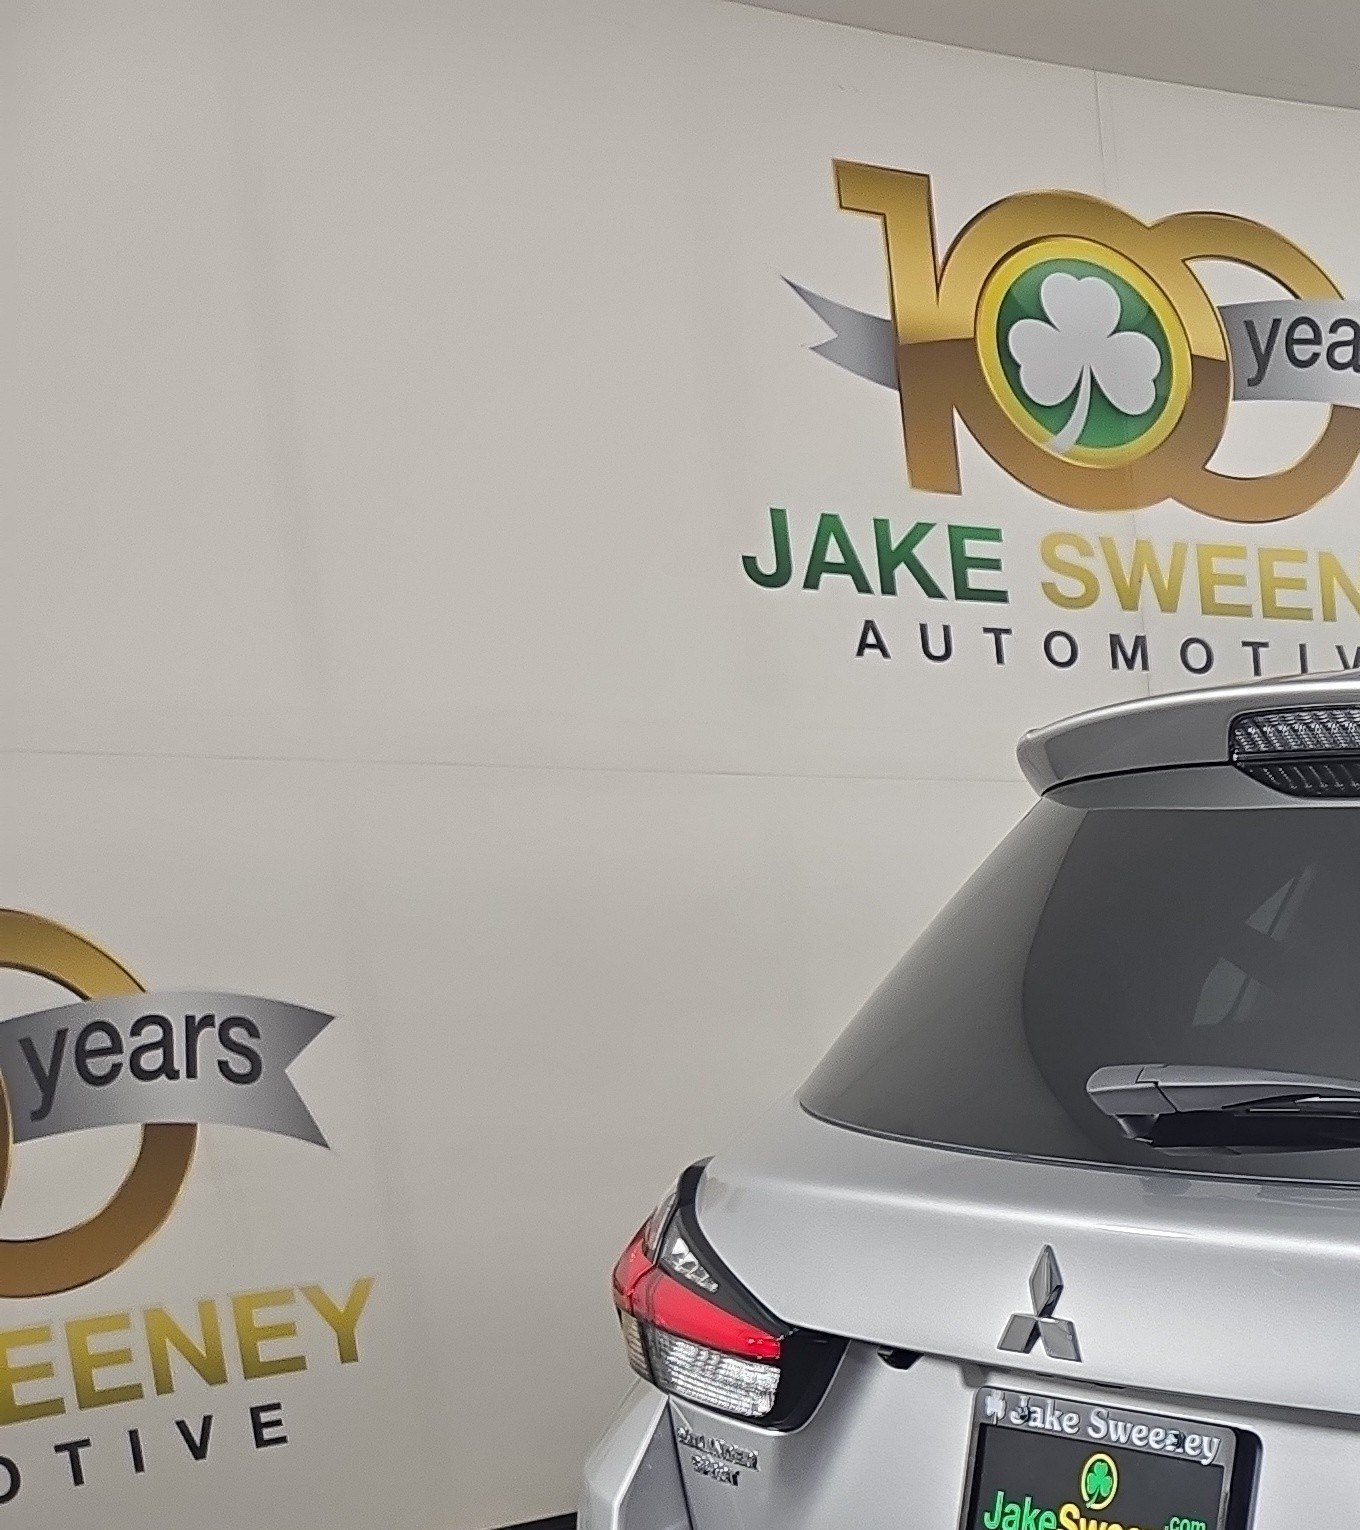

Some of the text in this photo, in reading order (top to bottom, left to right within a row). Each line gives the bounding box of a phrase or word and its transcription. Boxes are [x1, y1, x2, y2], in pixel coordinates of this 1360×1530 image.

[742, 506, 1010, 603] JAKE
[19, 1012, 263, 1121] years
[0, 1277, 375, 1427] EENEY
[1010, 1395, 1221, 1465] Jake Sweeney
